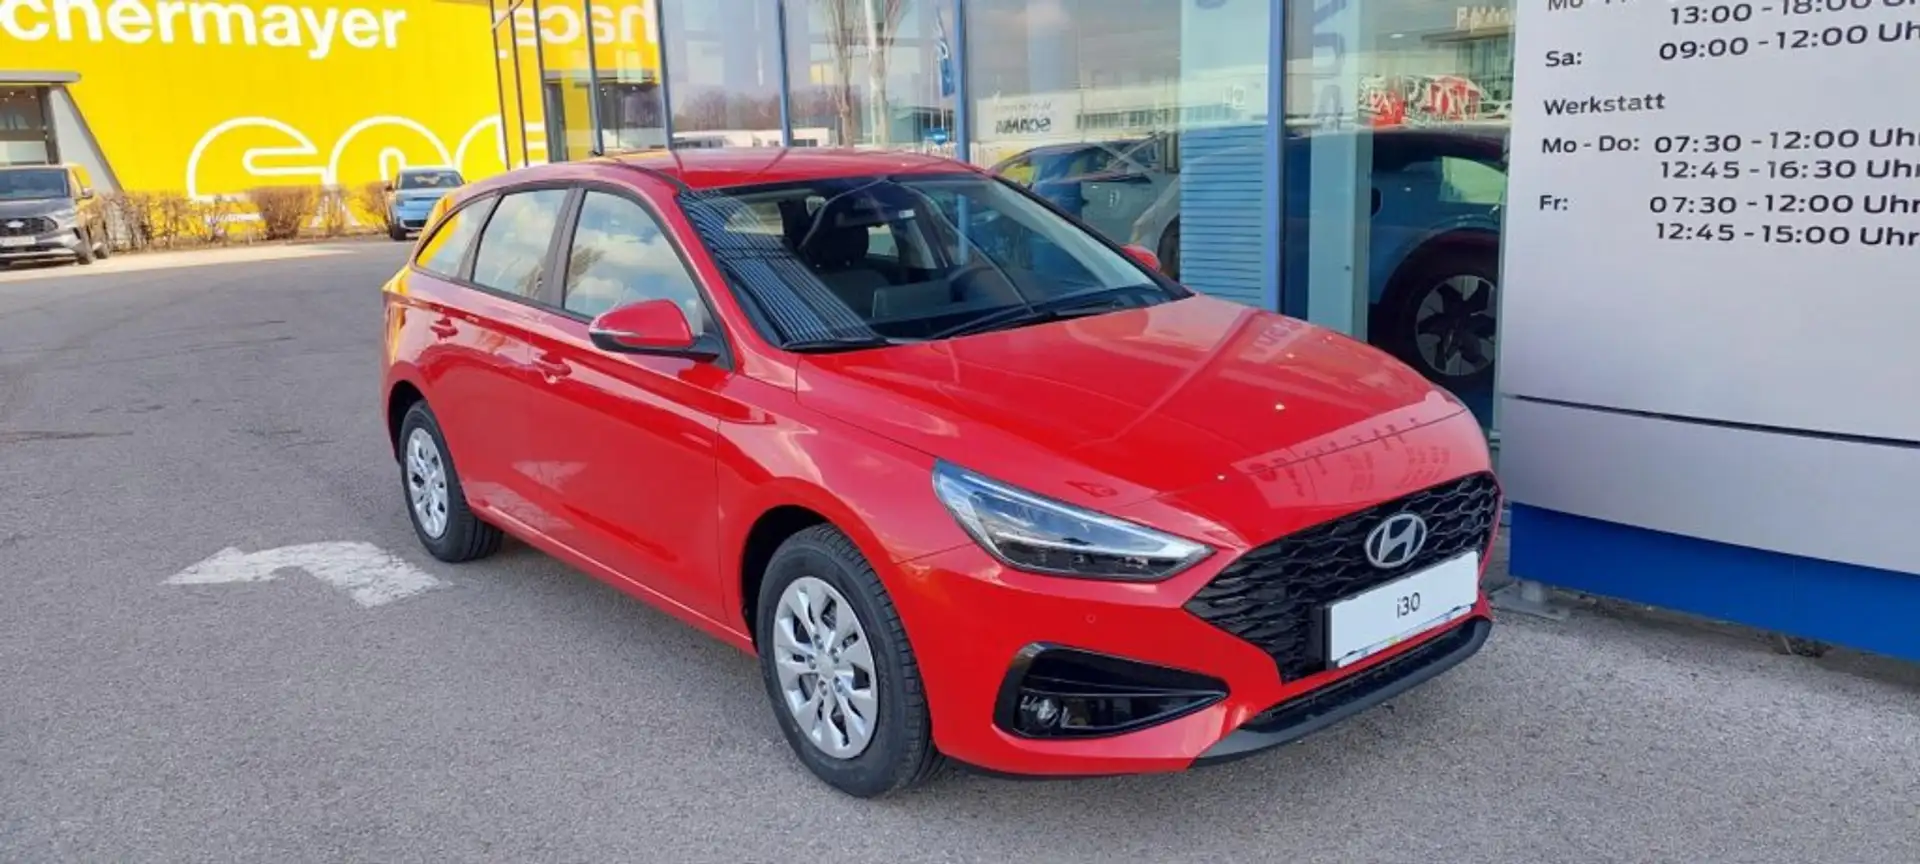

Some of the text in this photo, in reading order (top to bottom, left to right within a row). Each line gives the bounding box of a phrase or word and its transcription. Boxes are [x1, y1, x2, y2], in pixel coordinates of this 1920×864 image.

[1670, 4, 1752, 25] 13:00
[0, 0, 406, 60] chermayer
[1659, 37, 1748, 60] 09:00
[1776, 25, 1868, 49] 12:00
[1545, 50, 1582, 67] Sa:
[1544, 94, 1665, 115] Werkstatt
[1541, 138, 1577, 153] Mo
[1599, 136, 1640, 152] Do:
[1654, 135, 1742, 153] 07:30
[1769, 129, 1859, 149] 12:00
[1869, 127, 1920, 147] Uh
[1660, 161, 1740, 179] 12:45
[1768, 160, 1856, 178] 16:30
[1539, 195, 1568, 211] Fr:
[1649, 196, 1737, 213] 07:30
[1765, 194, 1854, 213] 12:00
[1656, 223, 1735, 241] 12:45
[1763, 225, 1850, 244] 15:00
[1860, 226, 1920, 246] Uhr
[1397, 592, 1421, 618] i30
